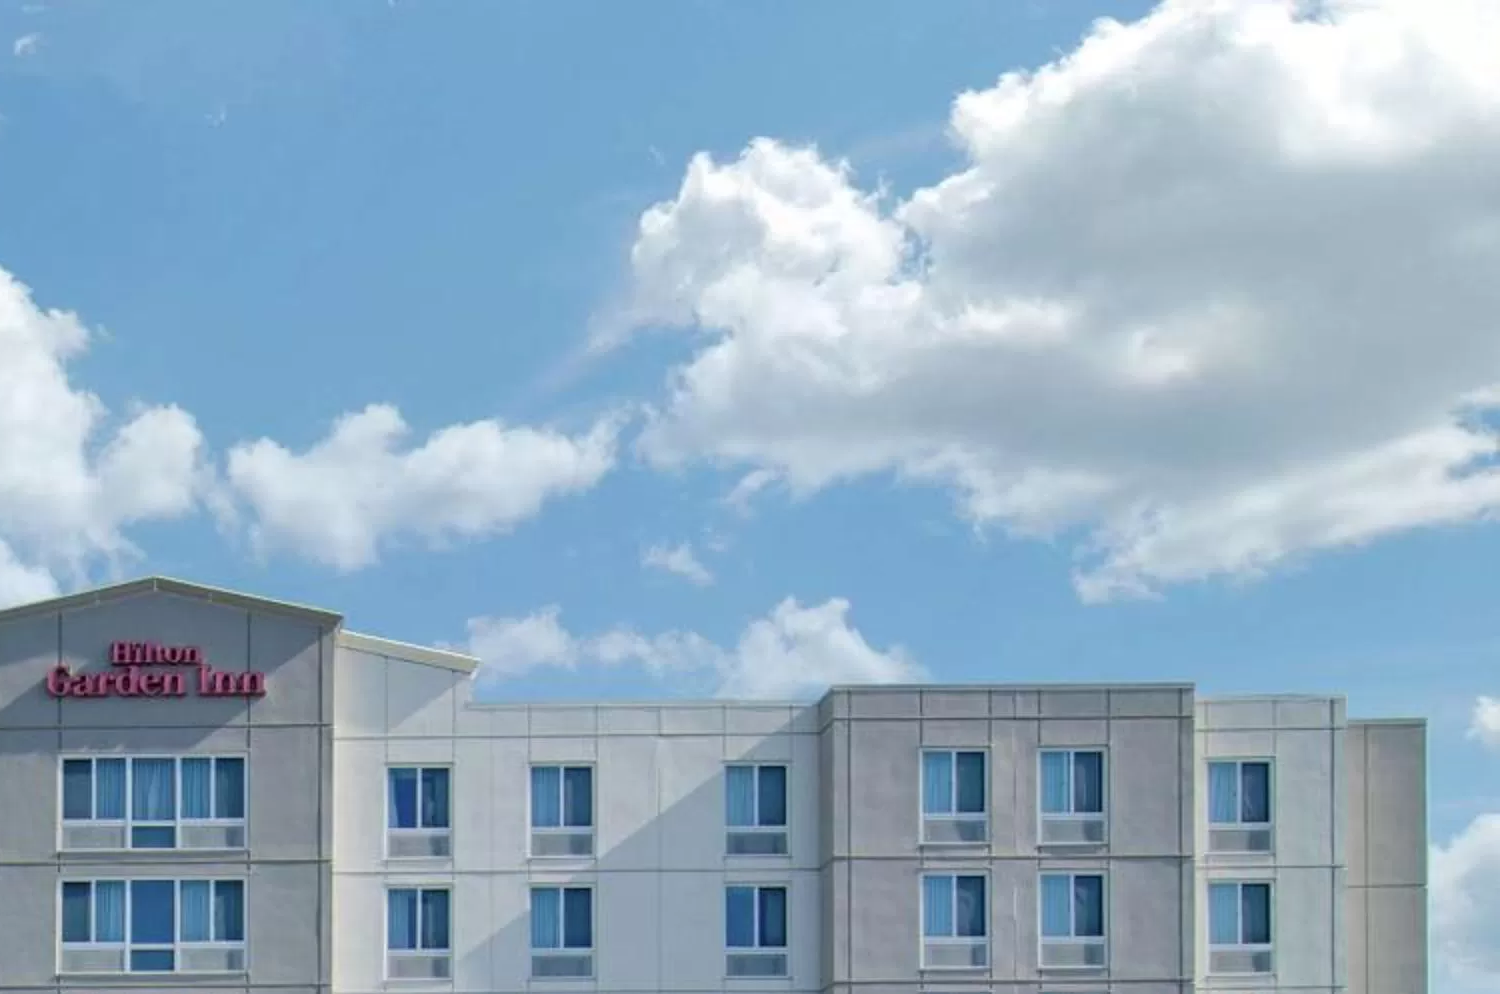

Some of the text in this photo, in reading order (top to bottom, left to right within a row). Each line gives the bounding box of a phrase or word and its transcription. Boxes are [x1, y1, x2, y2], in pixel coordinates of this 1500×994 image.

[110, 640, 201, 665] Hilton
[47, 663, 267, 698] Garden Inn
